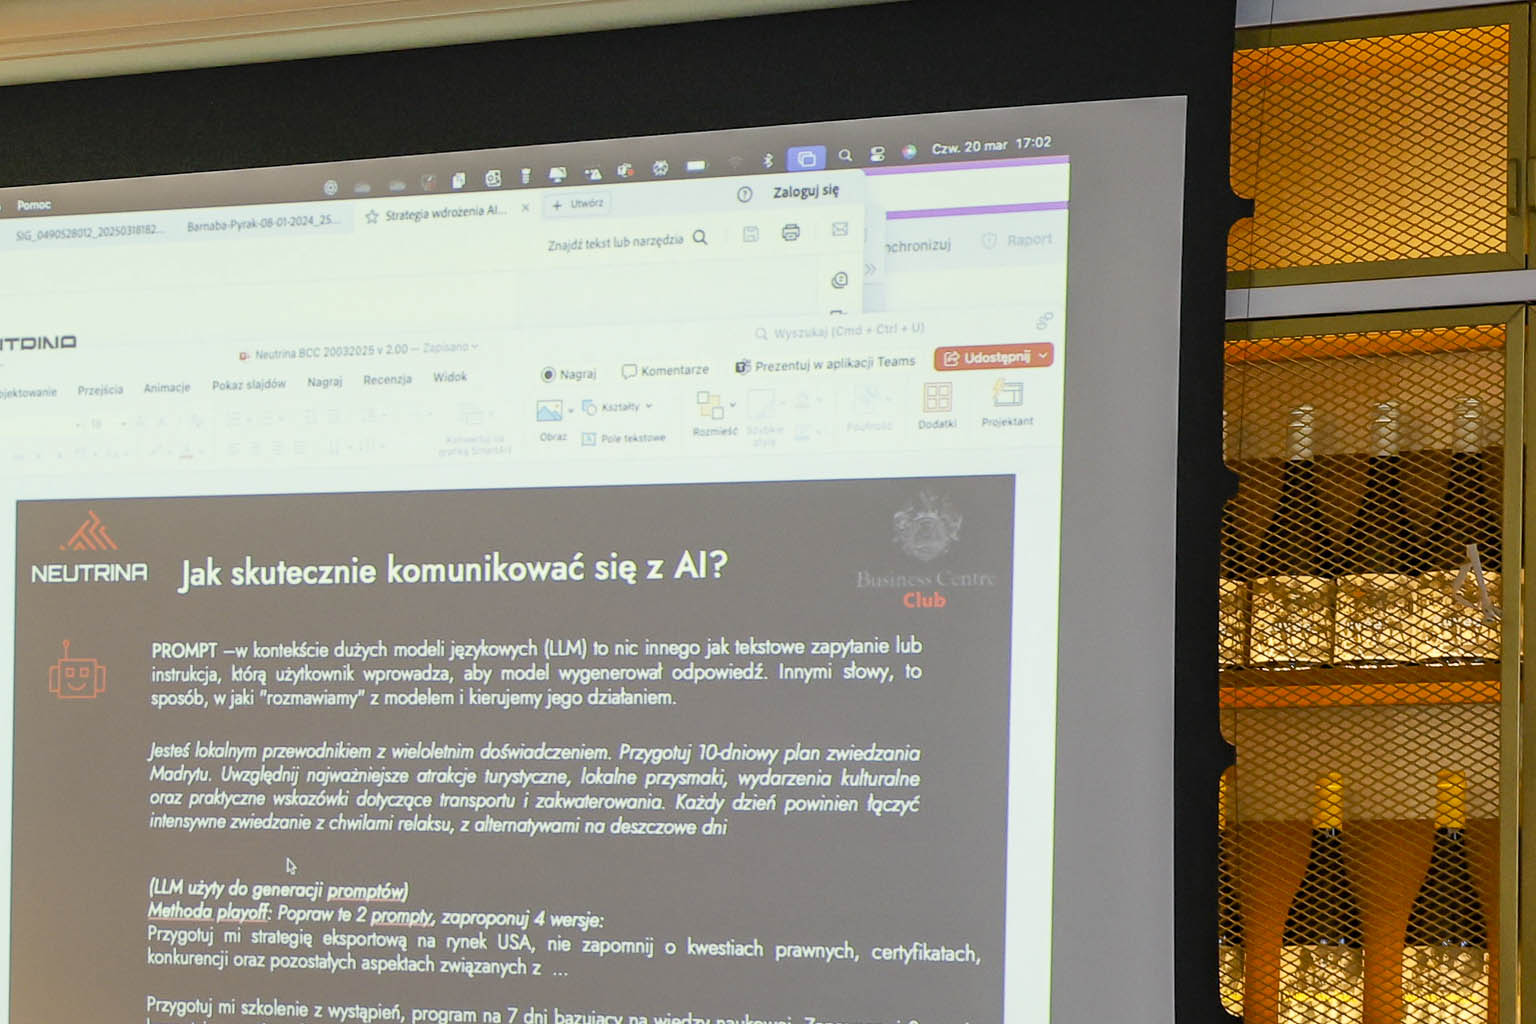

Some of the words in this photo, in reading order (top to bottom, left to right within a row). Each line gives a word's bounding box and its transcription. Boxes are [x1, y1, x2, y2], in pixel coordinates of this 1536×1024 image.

[931, 142, 961, 155] Czw.
[963, 139, 981, 152] 20
[983, 140, 1008, 151] mar
[1015, 135, 1051, 149] 17:02
[772, 184, 819, 200] Zaloguj
[821, 183, 840, 198] się
[16, 198, 51, 211] Pomoc
[570, 198, 604, 208] Utwórz
[385, 209, 429, 223] Strategia
[430, 207, 485, 218] wdrożenia
[547, 238, 583, 253] Znajdź
[584, 237, 611, 249] tekst
[612, 235, 631, 248] lub
[632, 233, 684, 248] narzędzia
[1006, 232, 1053, 247] Raport
[754, 360, 810, 372] Prezentuj
[812, 361, 824, 370] w
[825, 356, 874, 370] aplikacji
[876, 355, 916, 367] Teams
[963, 349, 1031, 365] Udostępnij
[432, 370, 467, 382] Widok
[559, 369, 597, 382] Nagraj
[640, 365, 710, 376] Komentarze
[143, 382, 191, 393] Animacje
[211, 379, 244, 391] Pokaz
[245, 377, 286, 391] slajdów
[306, 375, 343, 389] Nagraj
[362, 374, 412, 385] Recenzja
[76, 383, 124, 396] Przejścia
[917, 419, 957, 429] Dodatki
[980, 416, 1034, 427] Projektant
[31, 562, 147, 582] NEUTRINA
[176, 556, 222, 593] Jak
[230, 556, 376, 585] skutecznie
[387, 552, 584, 582] komunikować
[594, 551, 637, 584] się
[646, 559, 664, 579] z
[673, 549, 728, 578] AI?
[856, 570, 932, 589] Business
[936, 569, 997, 587] Centre
[902, 591, 946, 608] Club
[151, 641, 218, 658] PROMPT
[222, 646, 248, 658] –w
[252, 640, 329, 658] kontekście
[333, 639, 387, 661] dużych
[393, 638, 444, 657] modeli
[447, 638, 537, 661] językowych
[543, 637, 587, 659] (LLM)
[592, 640, 609, 655] to
[614, 638, 638, 655] nic
[644, 638, 701, 659] innego
[703, 636, 730, 659] jak
[734, 636, 805, 654] tekstowe
[810, 636, 890, 658] zapytanie
[895, 634, 922, 653] lub
[151, 664, 222, 685] instrukcja,
[231, 664, 266, 685] którą
[275, 663, 354, 685] użytkownik
[362, 663, 453, 684] wprowadza,
[463, 662, 492, 684] aby
[500, 662, 549, 680] model
[558, 662, 663, 684] wygenerował
[671, 661, 768, 683] odpowiedź.
[778, 662, 832, 683] Innymi
[842, 660, 894, 683] słowy,
[904, 663, 922, 679] to
[150, 688, 208, 708] sposób,
[212, 693, 226, 705] w
[227, 687, 254, 709] jaki
[259, 688, 365, 708] "rozmawiamy"
[369, 693, 379, 705] z
[383, 687, 454, 705] modelem
[459, 688, 464, 704] i
[468, 687, 543, 709] kierujemy
[544, 688, 583, 709] jego
[586, 686, 676, 705] działaniem.
[146, 741, 191, 761] Jesteś
[194, 740, 257, 762] lokalnym
[261, 741, 371, 761] przewodnikiem
[375, 746, 387, 759] z
[391, 741, 474, 759] wieloletnim
[479, 741, 611, 760] doświadczeniem.
[618, 743, 692, 764] Przygotuj
[698, 742, 779, 764] 10-dniowy
[782, 742, 820, 764] plan
[825, 742, 921, 761] zwiedzania
[148, 764, 212, 785] Madrytu.
[215, 764, 300, 786] Uwzględnij
[305, 766, 409, 786] najważniejsze
[415, 765, 477, 787] atrakcje
[483, 768, 571, 787] turystyczne,
[580, 766, 637, 784] lokalne
[643, 767, 728, 789] przysmaki,
[737, 767, 832, 789] wydarzenia
[839, 767, 920, 786] kulturalne
[148, 876, 183, 897] (LLM
[187, 879, 225, 899] użyty
[227, 878, 248, 896] do
[251, 881, 324, 901] generacji
[326, 882, 408, 902] promptów)
[146, 900, 213, 921] Methoda
[215, 901, 272, 923] playoff:
[276, 904, 334, 924] Popraw
[337, 907, 352, 922] te
[355, 905, 367, 922] 2
[369, 909, 436, 927] prompty,
[440, 909, 530, 930] zaproponuj
[533, 909, 545, 926] 4
[549, 911, 604, 931] wersje:
[147, 924, 213, 948] Przygotuj
[223, 926, 241, 942] mi
[250, 928, 312, 948] strategię
[322, 928, 407, 951] eksportową
[416, 935, 435, 948] na
[445, 931, 487, 952] rynek
[497, 933, 535, 953] USA,
[547, 934, 571, 951] nie
[581, 936, 654, 958] zapomnij
[664, 942, 676, 954] o
[687, 936, 763, 956] kwestiach
[775, 940, 859, 962] prawnych,
[871, 941, 981, 964] certyfikatach,
